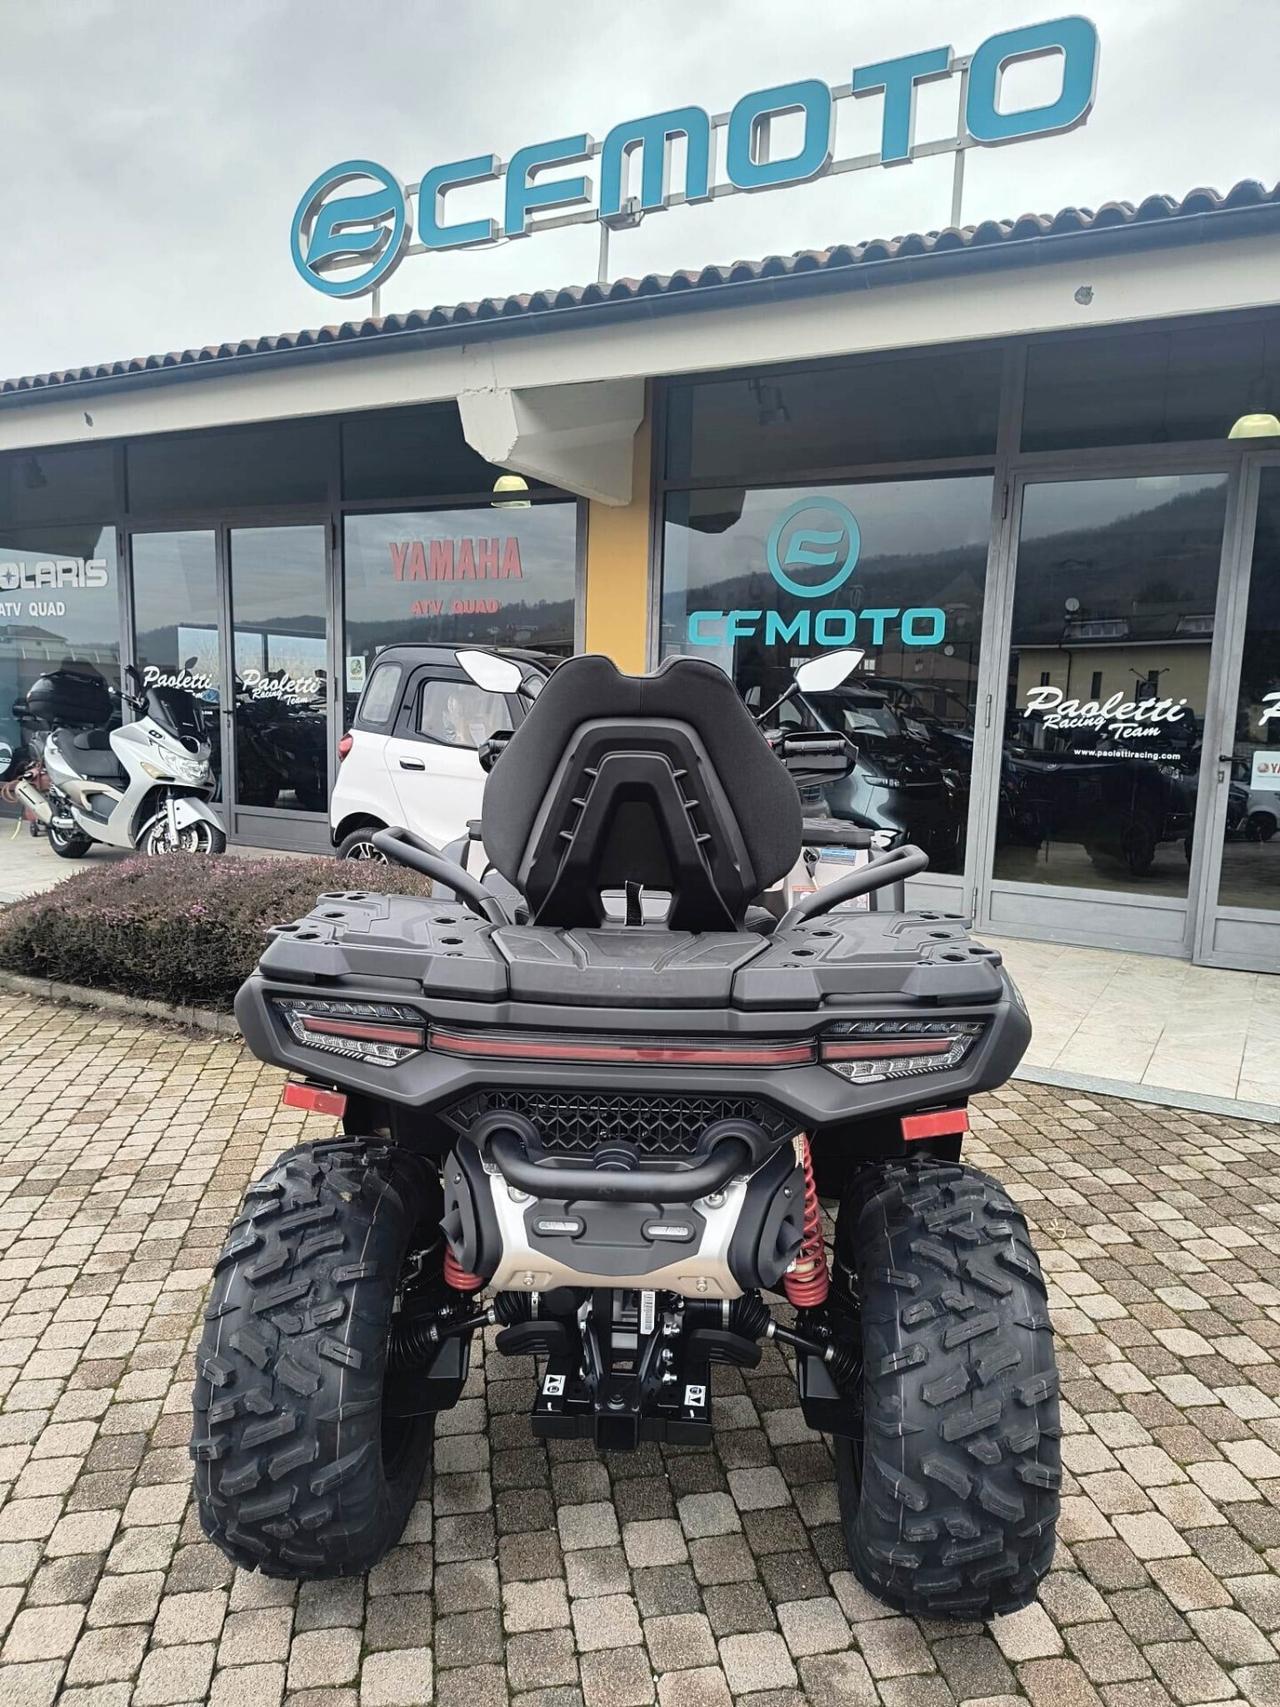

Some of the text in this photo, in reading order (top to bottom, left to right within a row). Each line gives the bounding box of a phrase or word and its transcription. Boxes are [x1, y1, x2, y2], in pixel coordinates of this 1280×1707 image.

[418, 15, 1100, 249] CFMOTO
[389, 537, 523, 581] YAMAHA
[29, 601, 66, 617] QUAD
[411, 599, 500, 616] ATV QUAD
[688, 608, 946, 646] CFMOTO
[143, 665, 213, 689] Paoletti
[242, 669, 321, 693] Paoletti
[252, 688, 309, 705] Racing Team
[1023, 686, 1187, 722] Paoletti
[1042, 713, 1161, 739] Racing Team
[1074, 748, 1181, 761] www.paolettiracing.com
